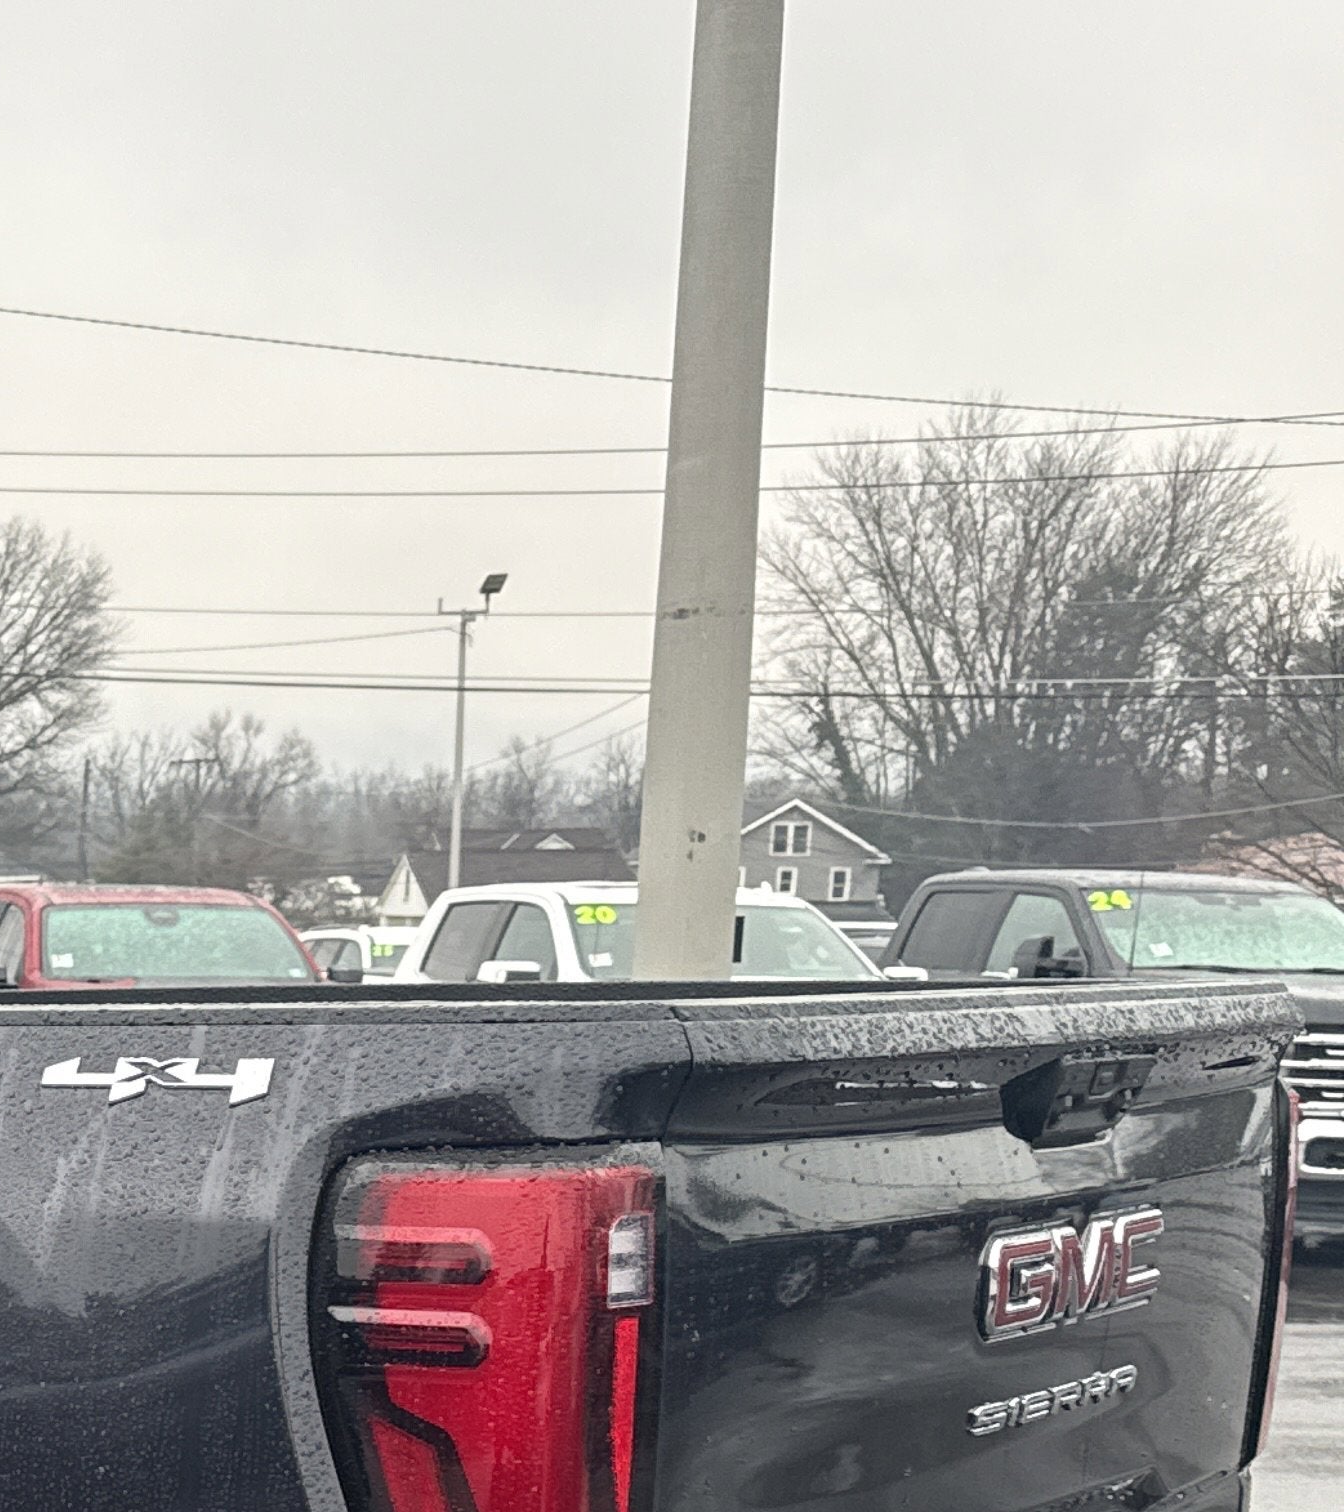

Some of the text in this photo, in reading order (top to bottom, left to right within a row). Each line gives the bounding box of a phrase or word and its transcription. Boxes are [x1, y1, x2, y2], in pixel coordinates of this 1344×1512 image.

[574, 905, 617, 925] 20
[1088, 889, 1132, 911] 24
[976, 1205, 1165, 1343] GMC
[966, 1363, 1139, 1437] SIERRA
